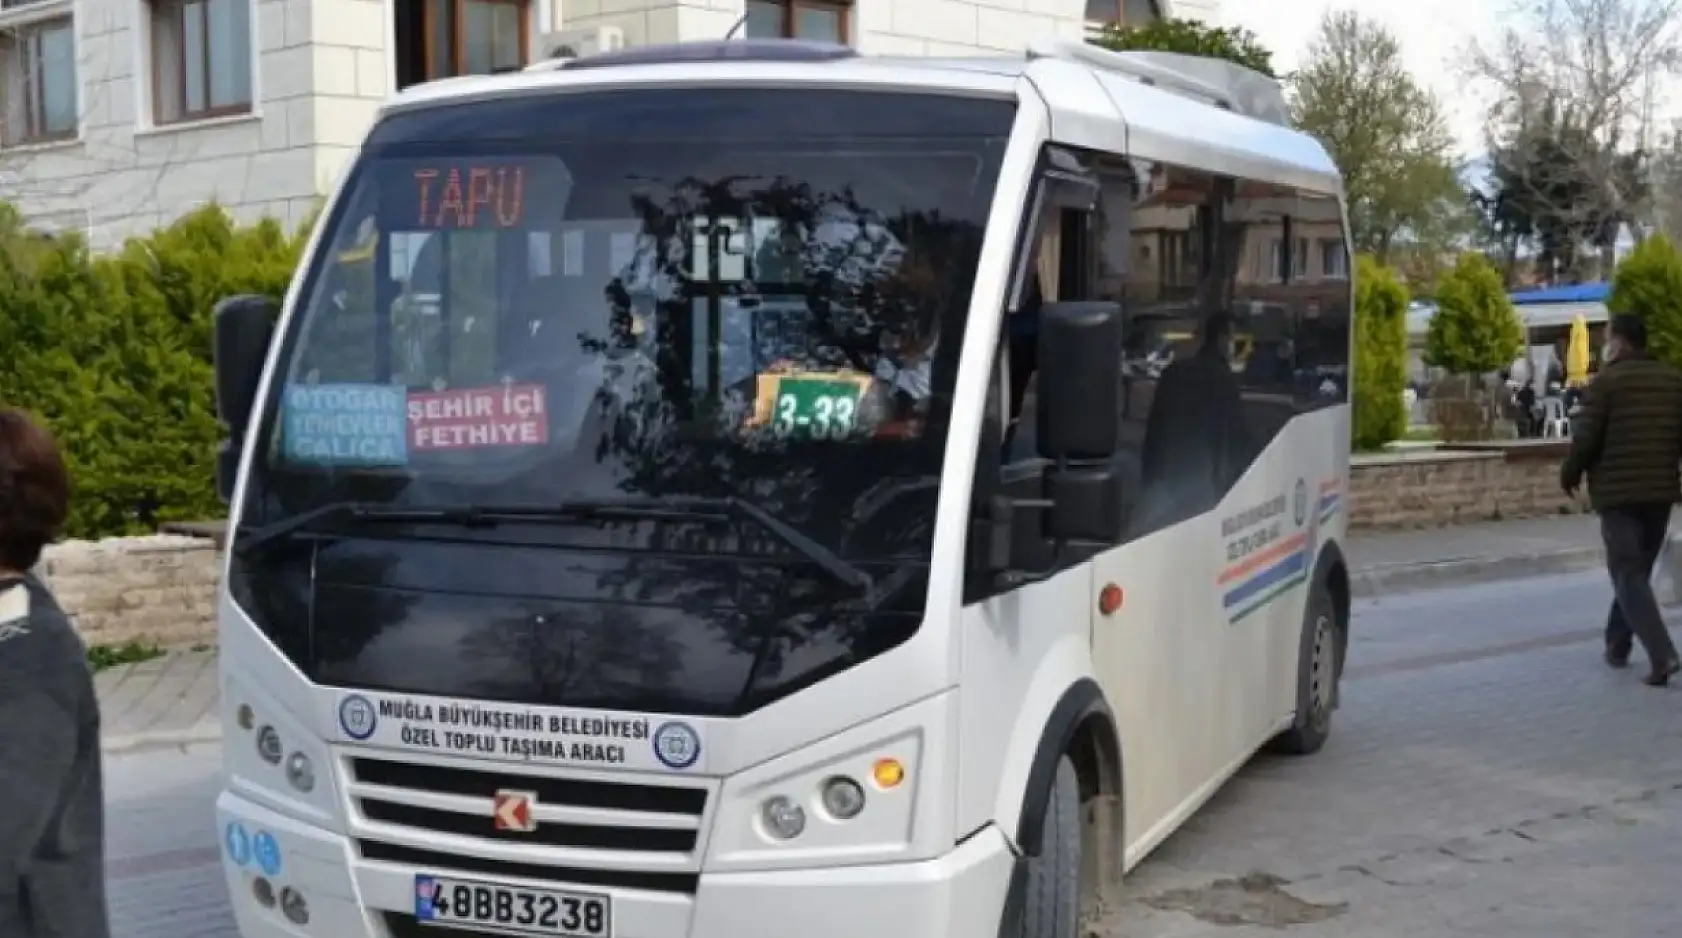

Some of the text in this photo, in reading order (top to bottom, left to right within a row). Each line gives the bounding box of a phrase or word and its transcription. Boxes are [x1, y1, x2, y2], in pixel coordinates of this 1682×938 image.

[413, 167, 523, 227] TAPU
[408, 386, 544, 425] ŞEHİR İÇİ
[774, 393, 854, 439] 3-33
[415, 419, 540, 448] FETHİYE
[379, 698, 648, 740] MUĞLA BÜYÜKŞEHİR BELEDİYESİ
[401, 722, 625, 764] ÖZEL TOPLU TAŞIMA ARACI
[432, 884, 604, 933] 48BB3238
